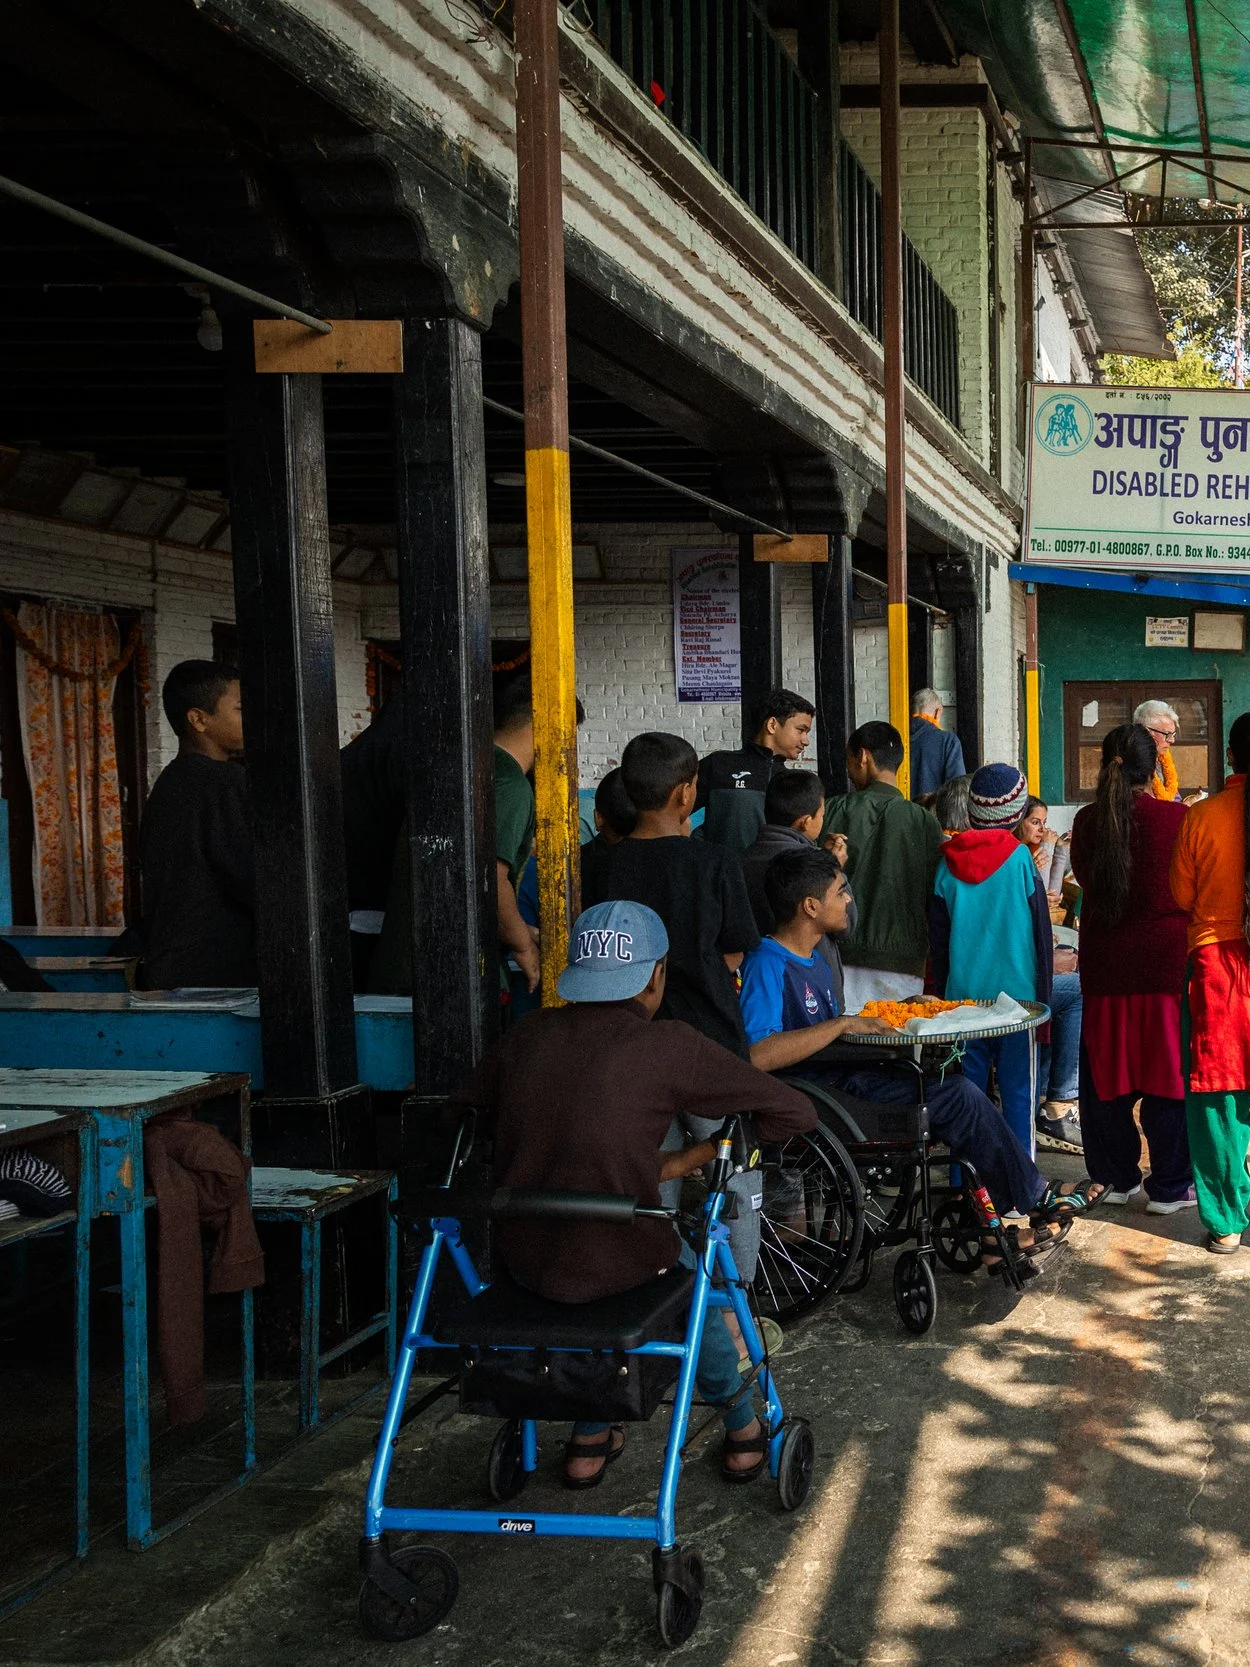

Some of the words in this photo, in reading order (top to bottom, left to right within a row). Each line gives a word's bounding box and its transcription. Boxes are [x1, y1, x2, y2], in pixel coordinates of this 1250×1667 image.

[1093, 412, 1189, 469] अपाङ्ग
[1092, 470, 1199, 499] DISABLED
[1054, 540, 1153, 557] 00977-01-4800867,
[1156, 544, 1181, 557] G.P.O.
[1185, 545, 1203, 558] Box
[1205, 546, 1225, 559] No.:
[575, 929, 633, 963] NYC
[501, 1520, 532, 1531] drive
